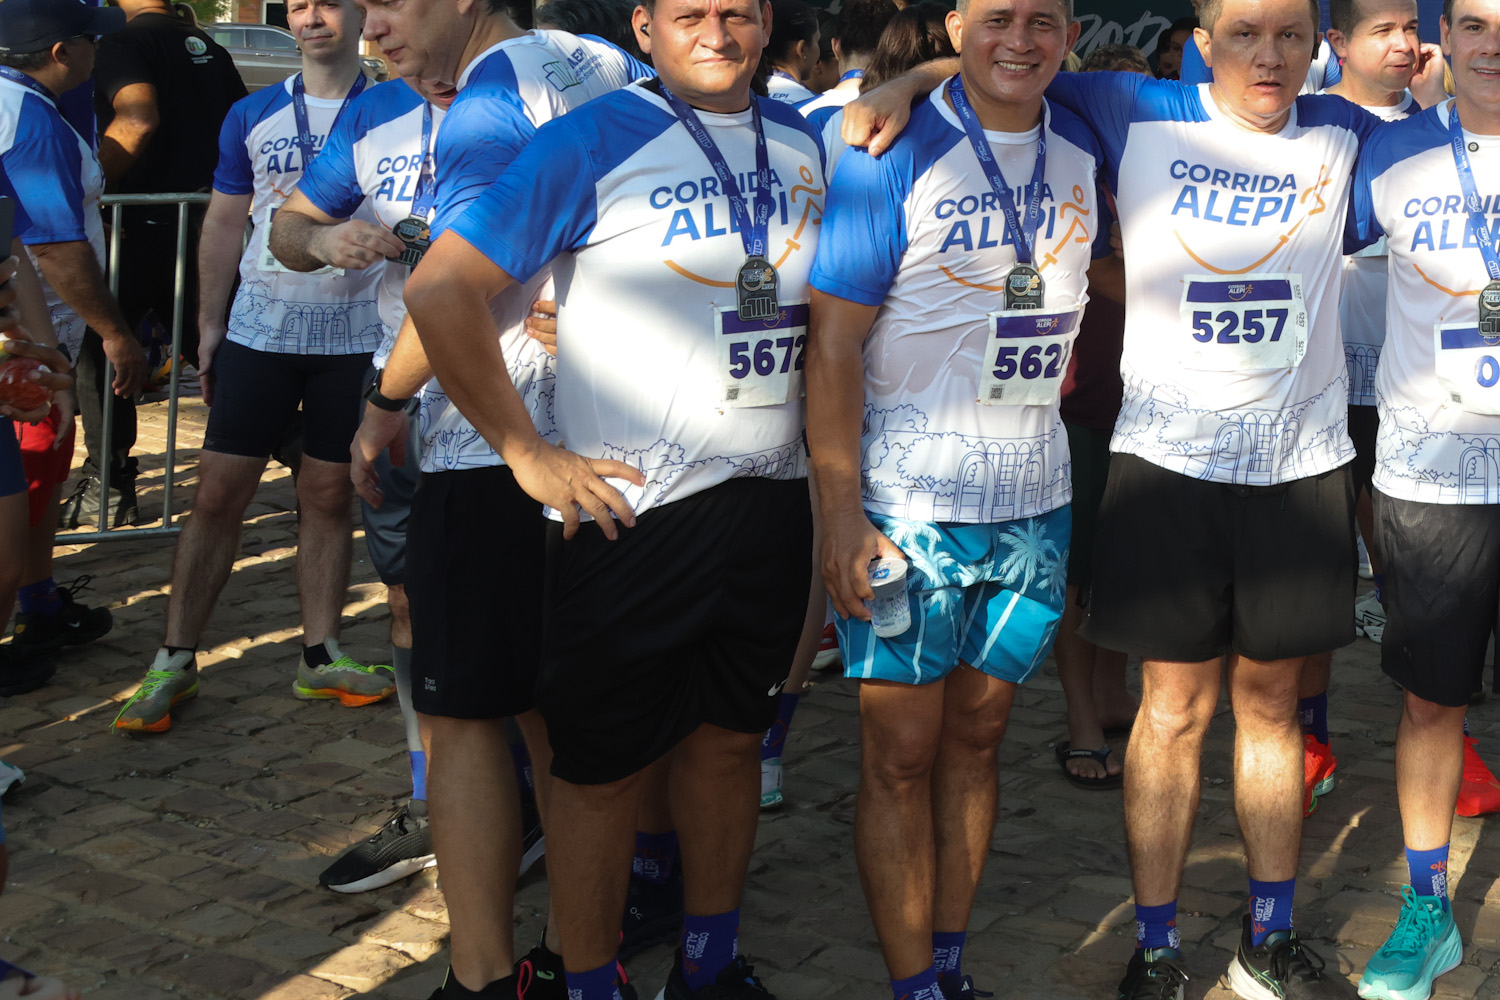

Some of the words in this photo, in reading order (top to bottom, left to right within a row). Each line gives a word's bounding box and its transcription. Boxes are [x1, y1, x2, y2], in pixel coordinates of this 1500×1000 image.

[1170, 159, 1297, 193] CORRIDA
[1171, 184, 1297, 226] ALEPI
[1192, 308, 1289, 344] 5257
[729, 335, 808, 380] 5672
[1255, 896, 1266, 922] ALEPI
[686, 931, 699, 959] ALEPI
